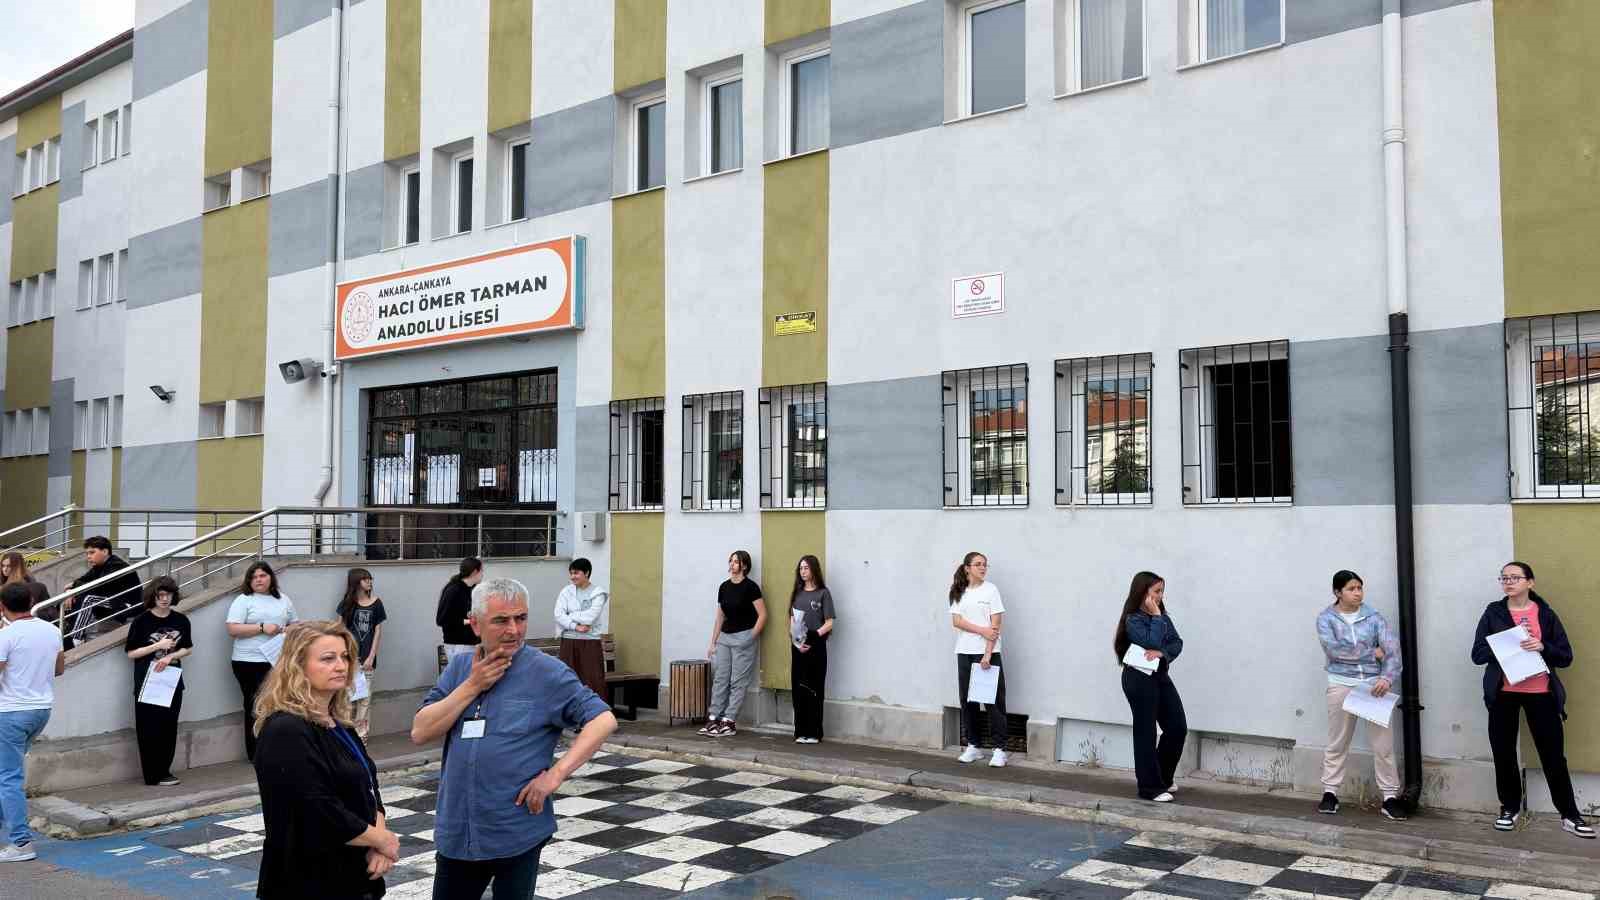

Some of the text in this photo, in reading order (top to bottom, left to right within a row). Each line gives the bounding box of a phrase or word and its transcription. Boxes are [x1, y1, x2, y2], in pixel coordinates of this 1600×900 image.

[378, 275, 451, 298] ANKARA-ÇANKAYA
[378, 275, 547, 319] HACI ÖMER TARMAN
[377, 304, 499, 341] ANADOLU LİSESİ
